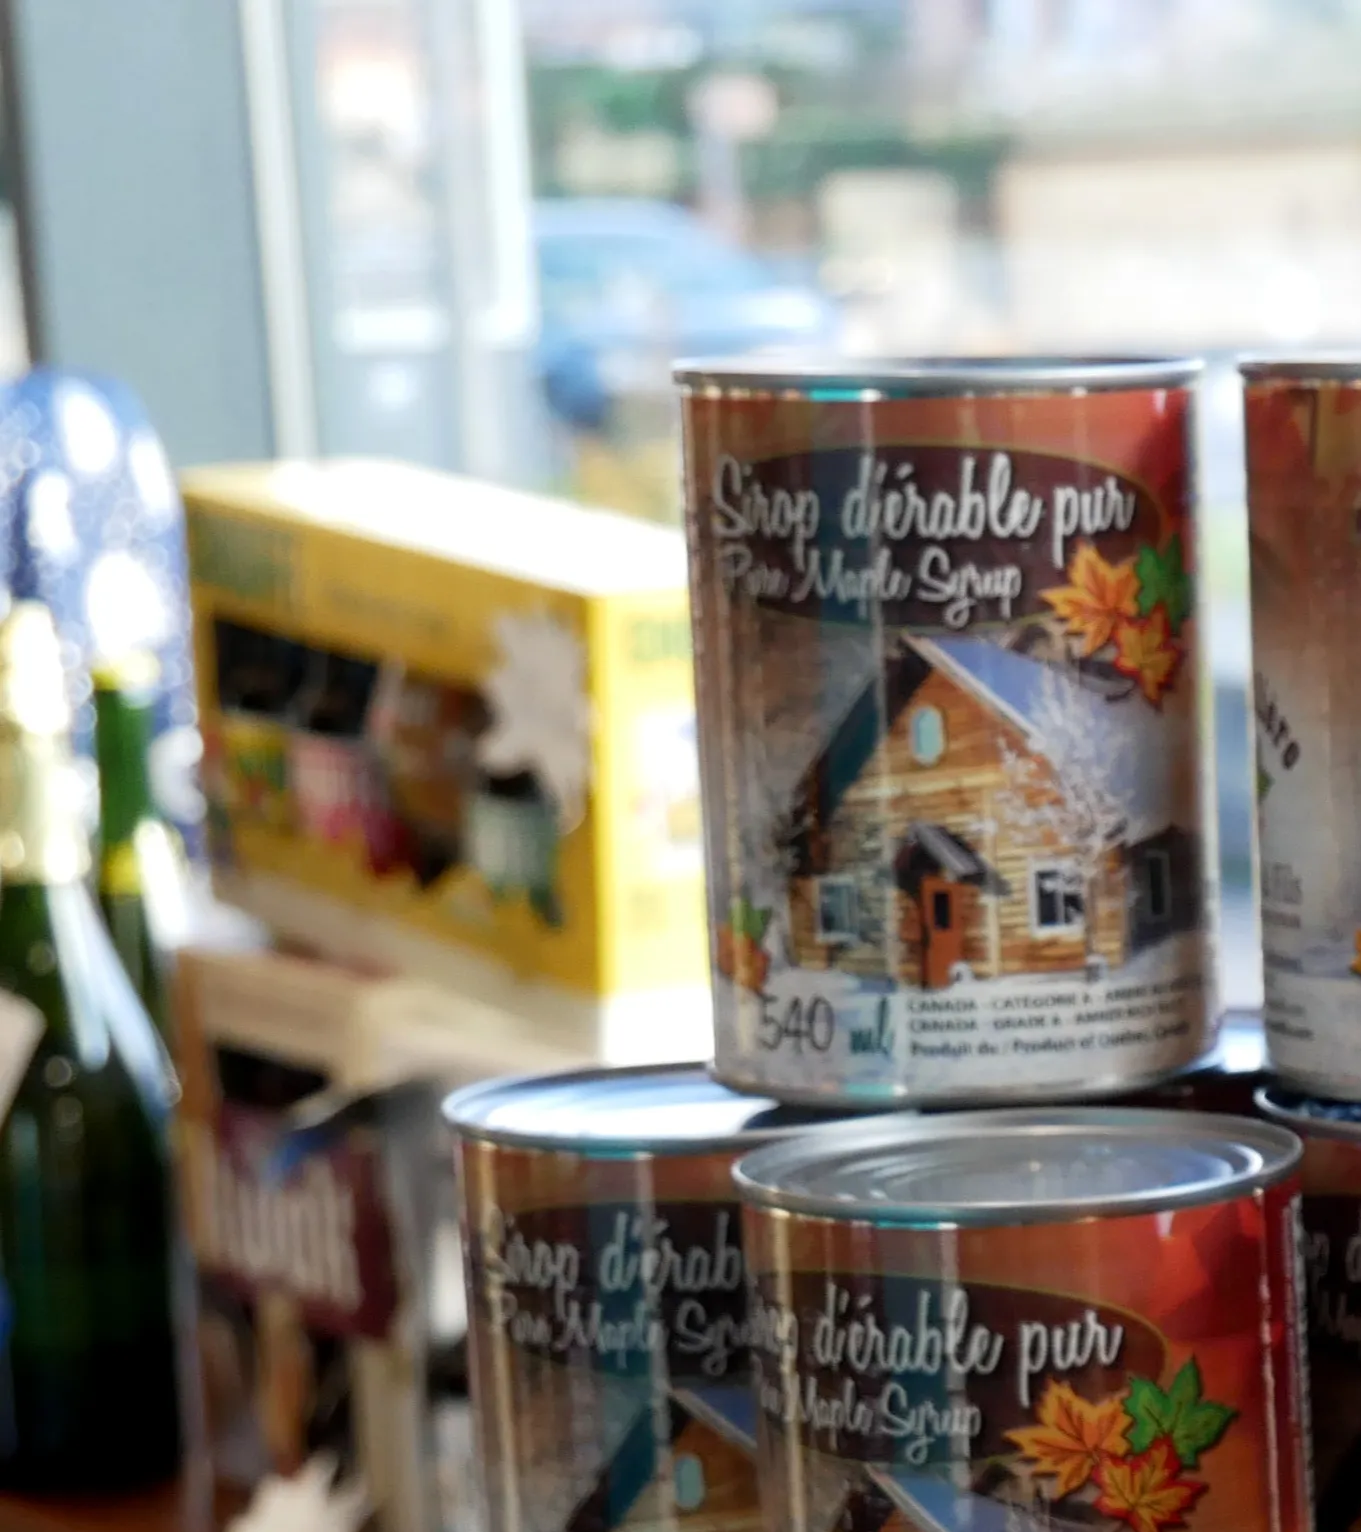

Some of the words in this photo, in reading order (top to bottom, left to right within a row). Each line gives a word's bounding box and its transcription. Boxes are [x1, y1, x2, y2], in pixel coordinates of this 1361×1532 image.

[714, 455, 819, 567] Sirop
[842, 452, 1047, 539] d'érable
[1053, 476, 1136, 567] pur
[792, 546, 909, 618] Maple
[917, 546, 1022, 627] Syrup
[757, 995, 835, 1053] 540
[813, 1282, 1005, 1376] d'érable
[1016, 1309, 1124, 1408] pur
[878, 1383, 982, 1465] Syrup
